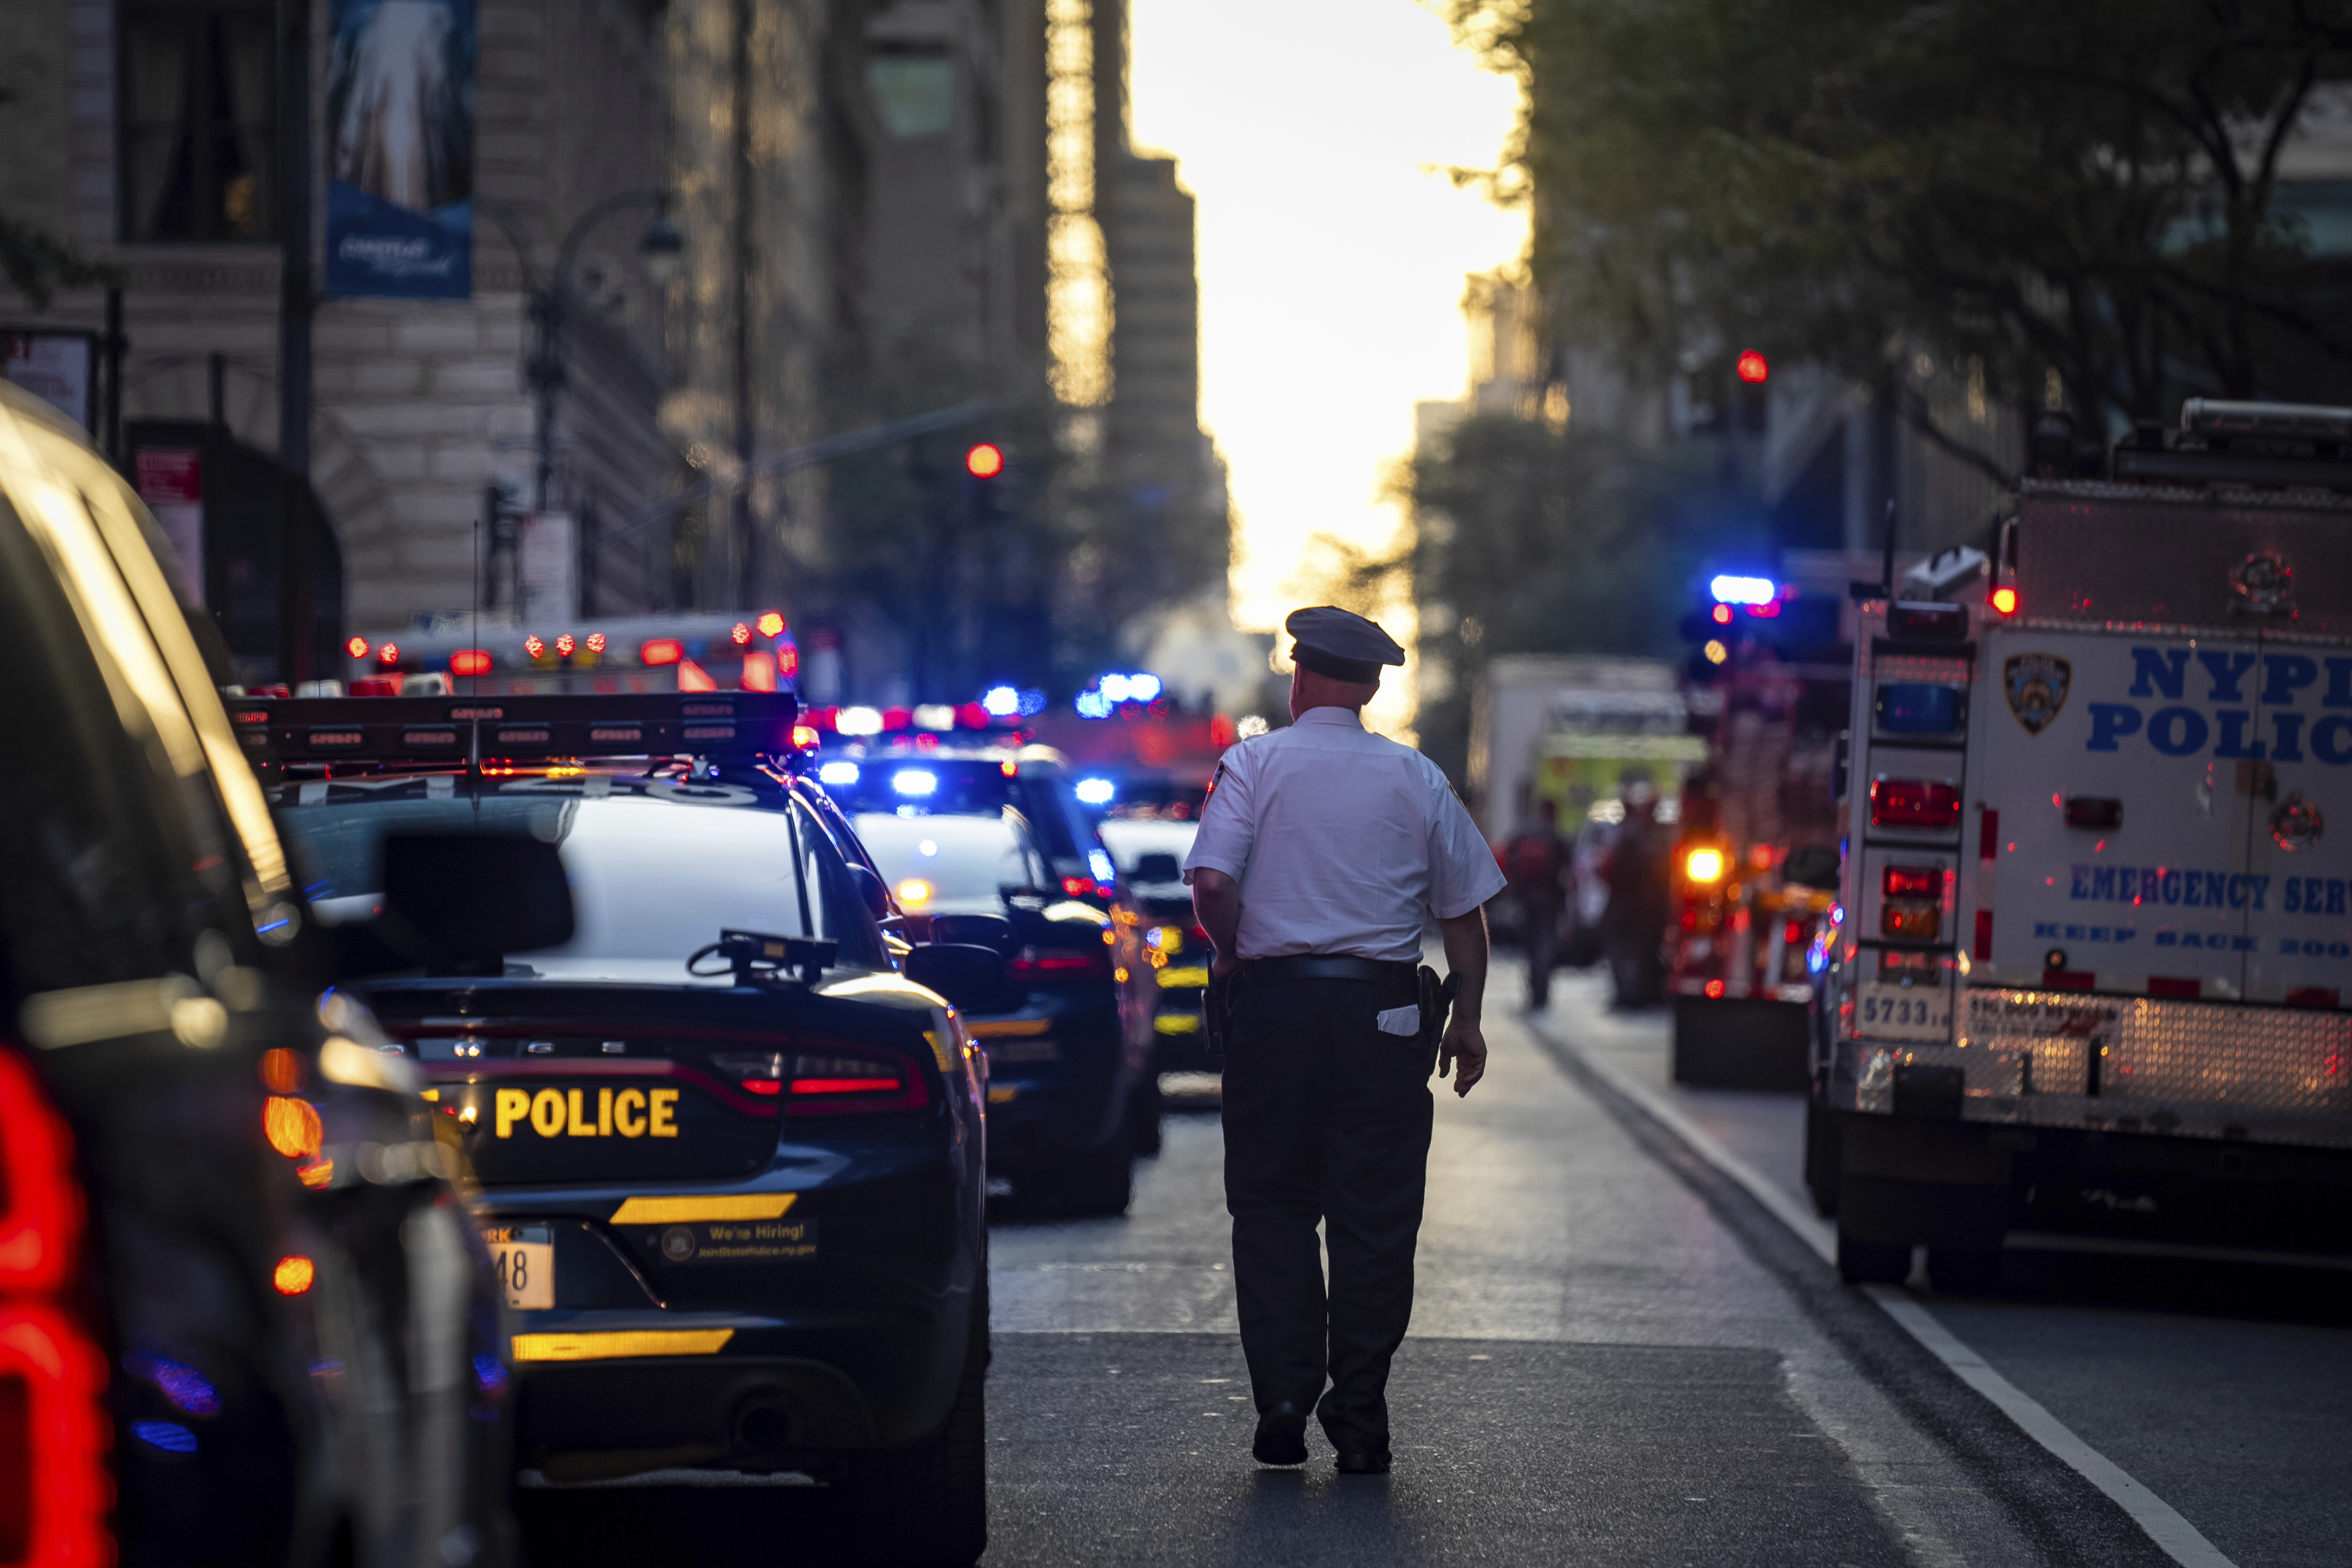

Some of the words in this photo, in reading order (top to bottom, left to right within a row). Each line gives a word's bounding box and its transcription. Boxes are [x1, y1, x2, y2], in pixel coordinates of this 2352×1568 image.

[2070, 864, 2270, 911] EMERGENCY
[2284, 877, 2352, 915] SER
[2034, 922, 2136, 943] KEEP
[2154, 931, 2259, 952] BACK
[2279, 938, 2350, 959] 200
[1865, 995, 1928, 1027] 5733
[380, 1039, 627, 1058] ODGE
[495, 1087, 680, 1139] POLICE
[756, 1223, 805, 1241] Hiring!
[495, 1250, 527, 1290] 48
